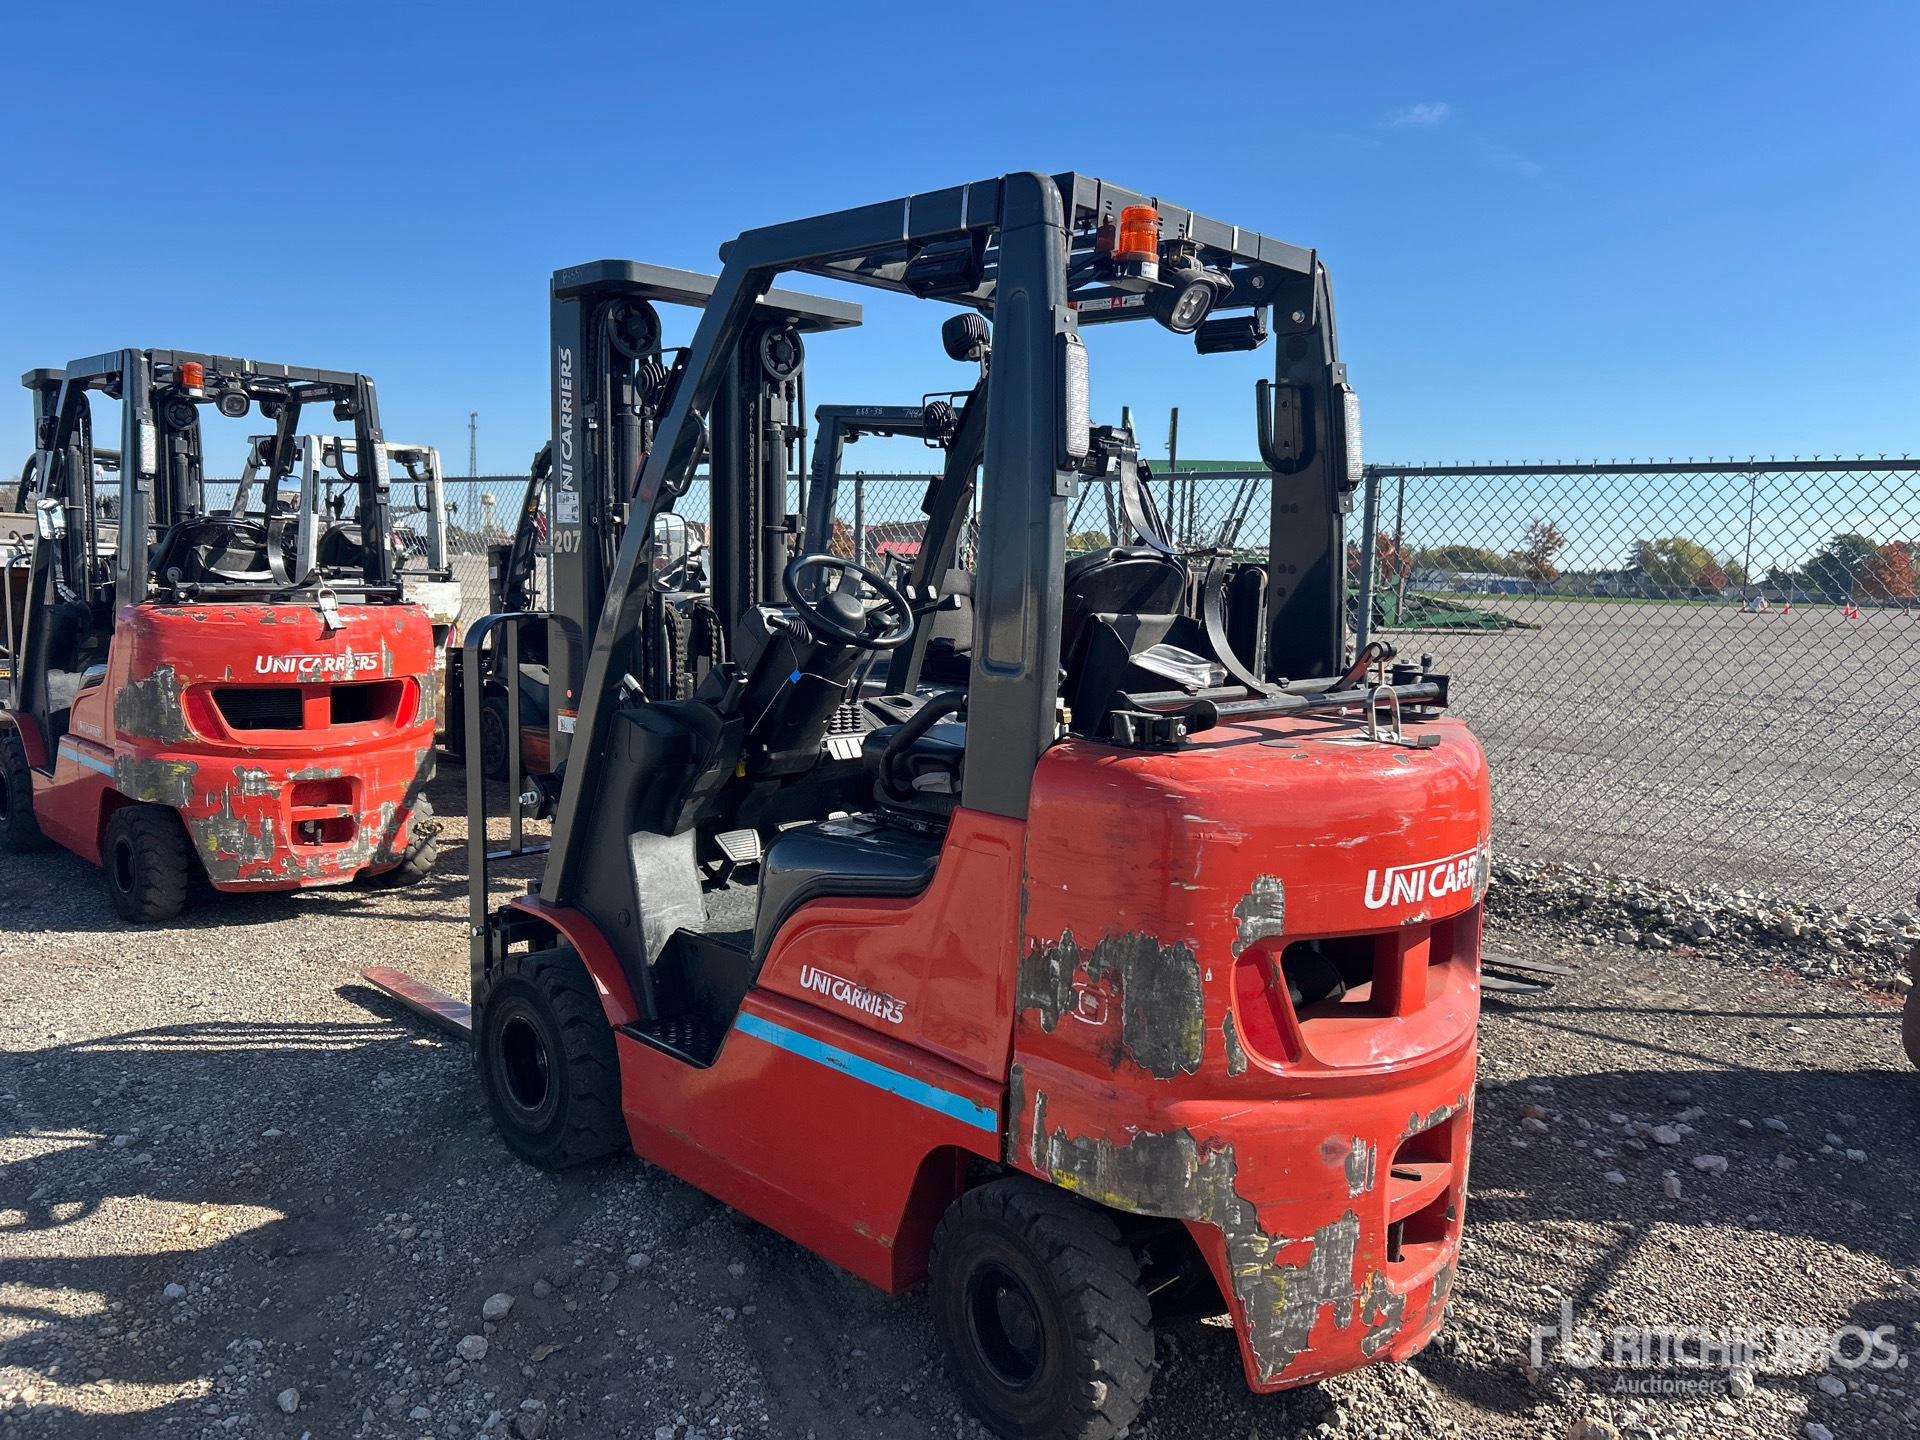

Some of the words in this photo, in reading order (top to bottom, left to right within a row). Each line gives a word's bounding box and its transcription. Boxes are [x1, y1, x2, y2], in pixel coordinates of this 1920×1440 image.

[559, 346, 573, 492] NICARRIERS
[554, 530, 581, 553] 207
[255, 652, 379, 674] UNICARRERS
[1364, 845, 1487, 909] UNICARR
[800, 964, 907, 1024] UNICARRIERS
